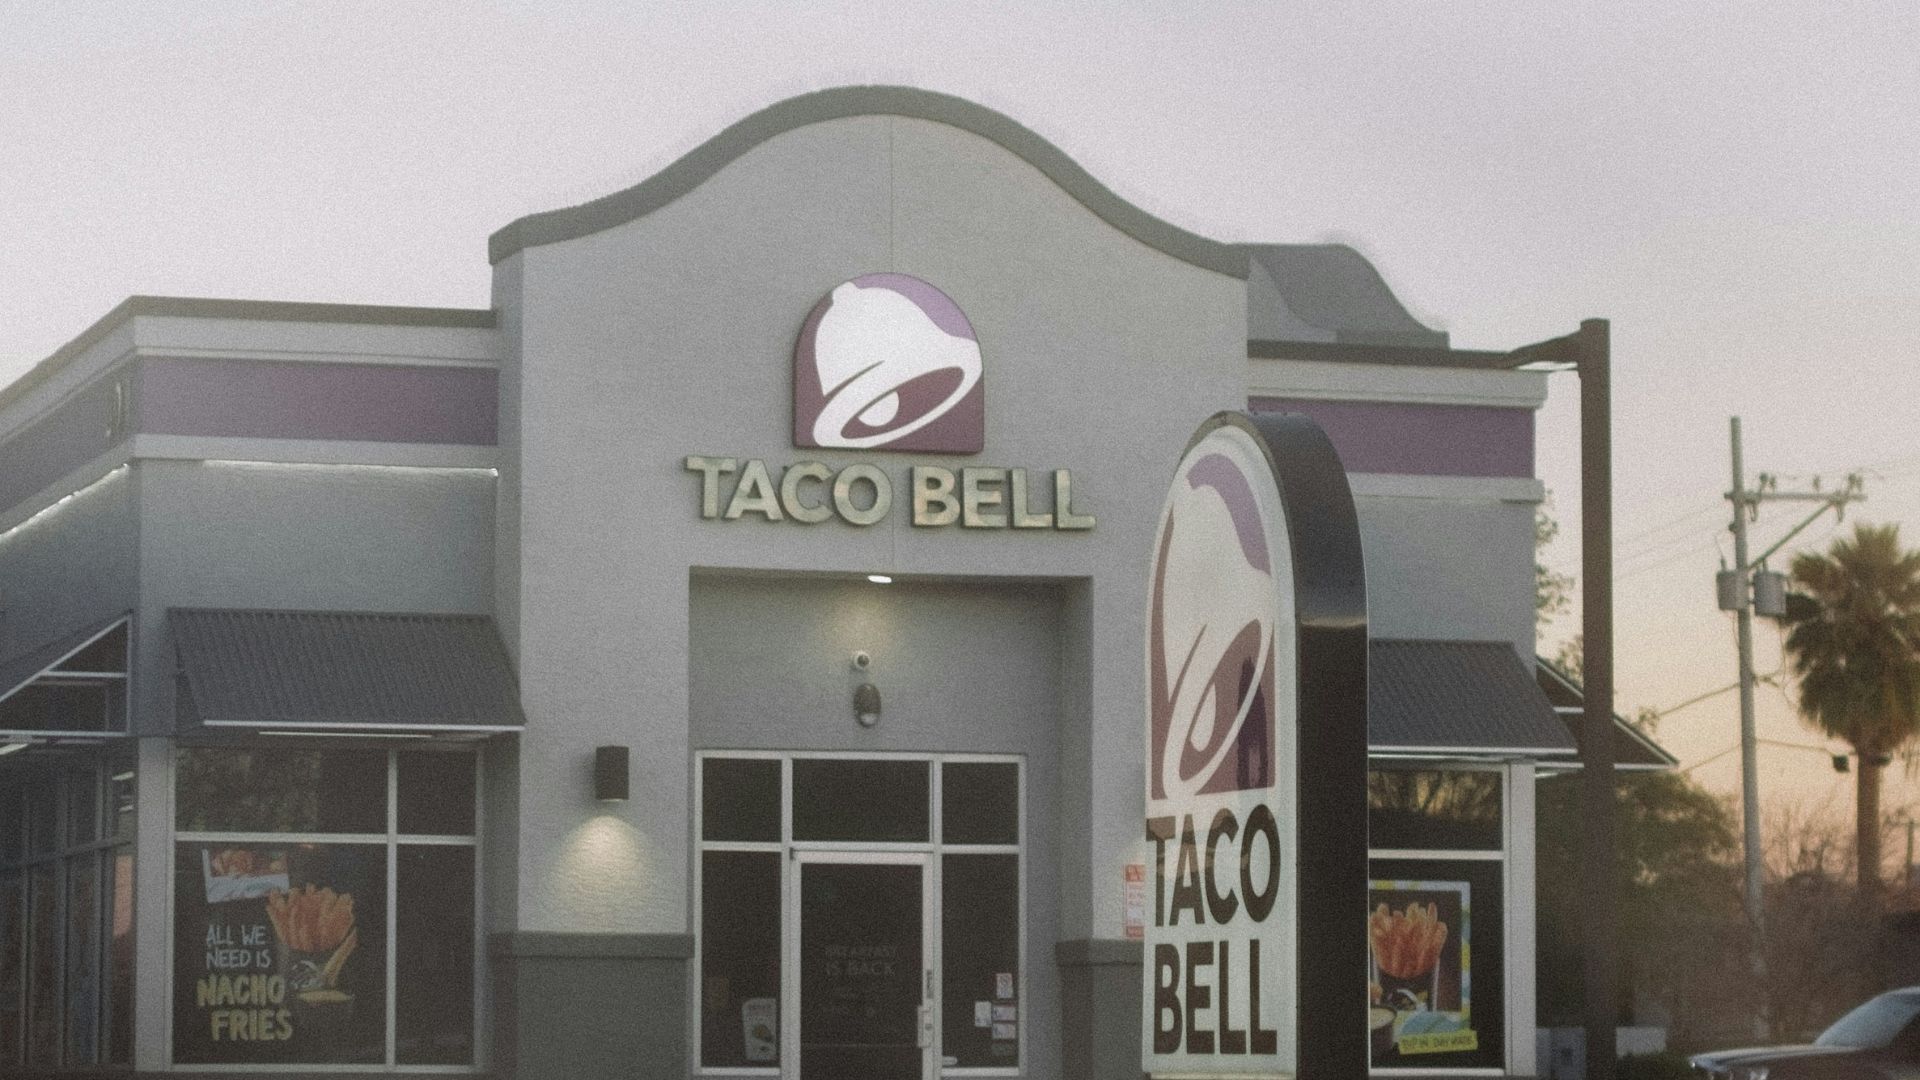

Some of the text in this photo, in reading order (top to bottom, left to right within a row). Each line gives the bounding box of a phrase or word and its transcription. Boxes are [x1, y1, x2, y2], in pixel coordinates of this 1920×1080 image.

[684, 455, 1097, 530] TACO BELL
[1146, 803, 1281, 927] TACO
[206, 924, 267, 947] ALL WE
[206, 948, 271, 969] NEED IS
[847, 960, 896, 976] BACK
[196, 974, 285, 1006] NACHO
[1153, 939, 1277, 1054] BELL
[210, 1009, 293, 1041] FRIES
